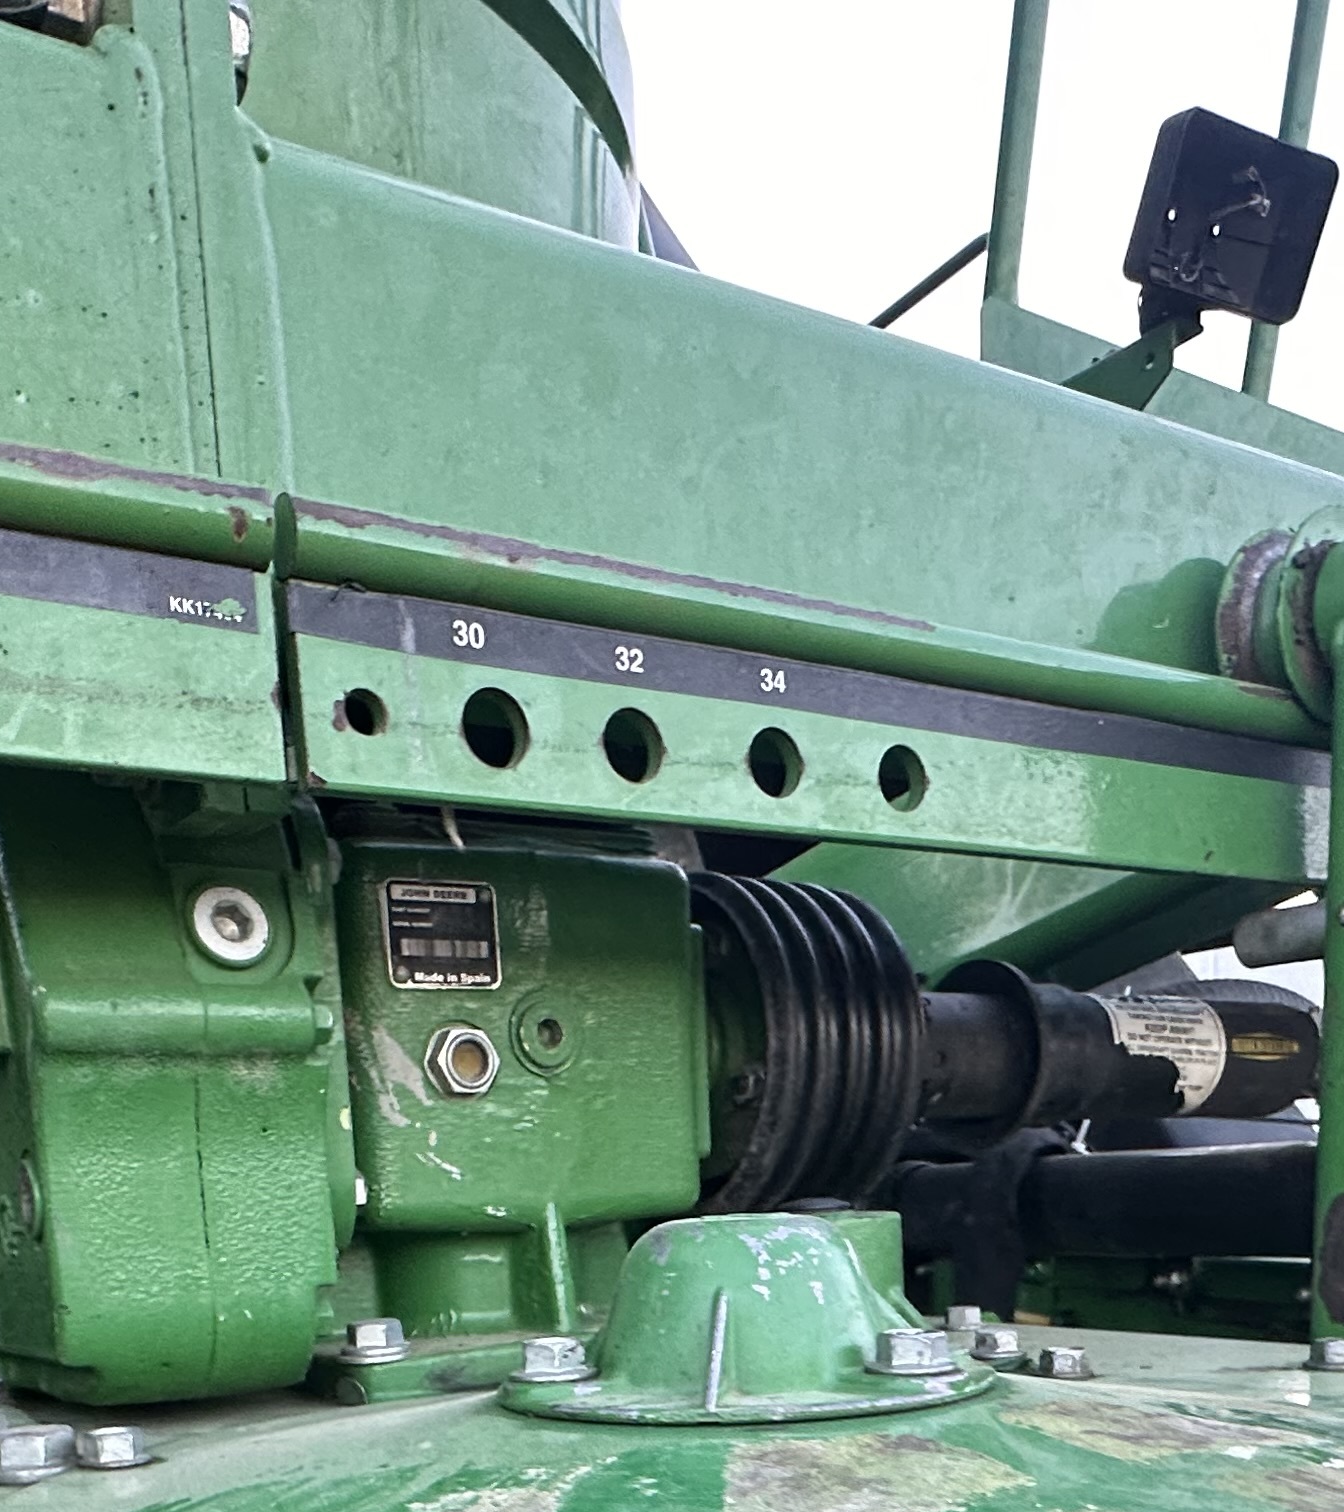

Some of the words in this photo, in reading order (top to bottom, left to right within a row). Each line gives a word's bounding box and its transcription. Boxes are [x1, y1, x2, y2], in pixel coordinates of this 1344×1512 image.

[452, 619, 485, 650] 30
[614, 646, 645, 674] 32
[760, 668, 787, 693] 34
[413, 971, 445, 983] Made
[447, 972, 458, 983] in
[460, 972, 492, 985] Spain
